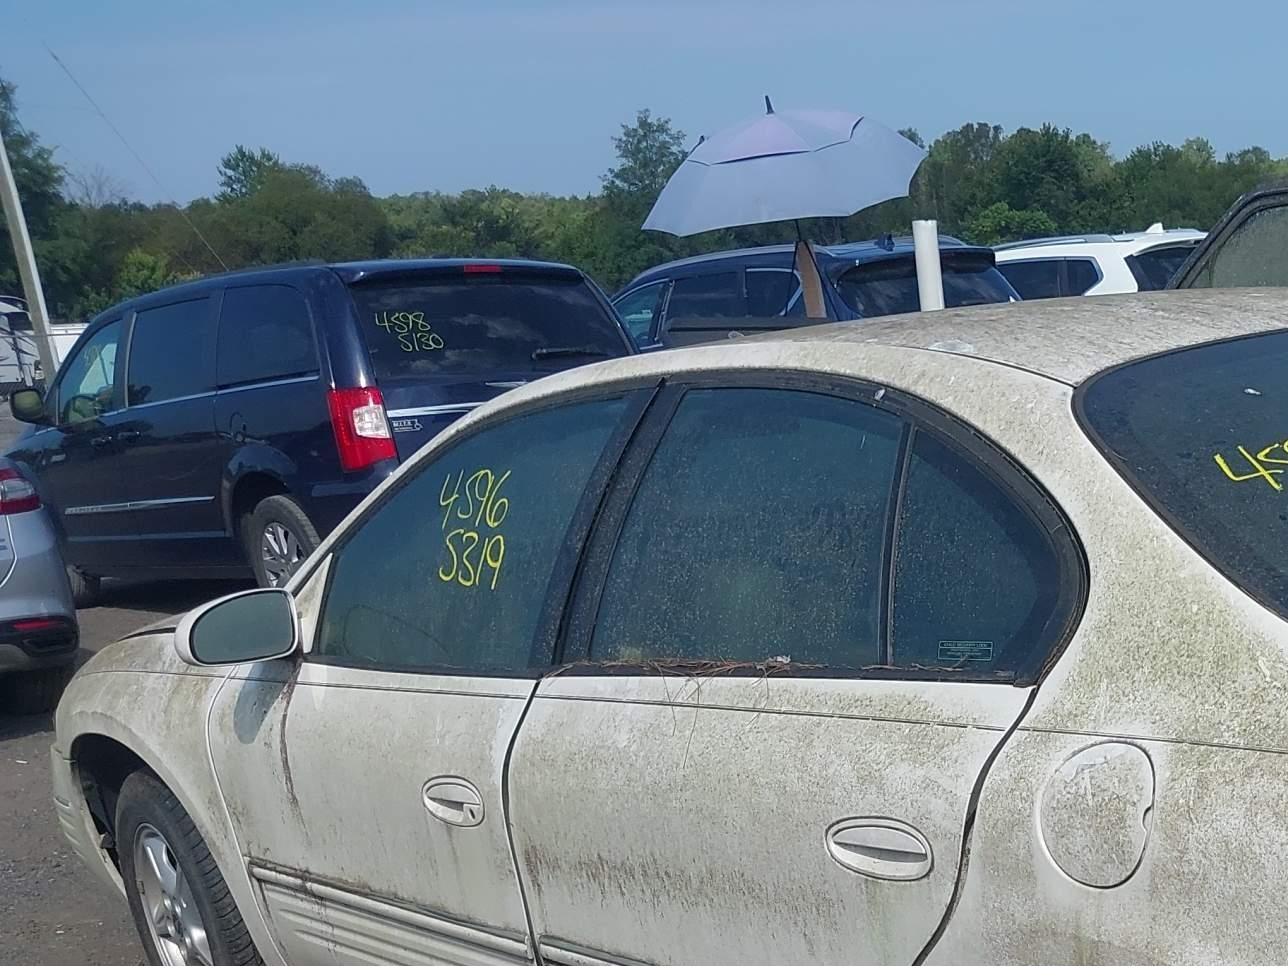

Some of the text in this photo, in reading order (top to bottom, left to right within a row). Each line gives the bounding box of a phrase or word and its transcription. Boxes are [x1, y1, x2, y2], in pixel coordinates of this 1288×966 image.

[374, 311, 431, 334] 4598
[439, 468, 512, 529] 4596
[438, 528, 505, 591] 5319
